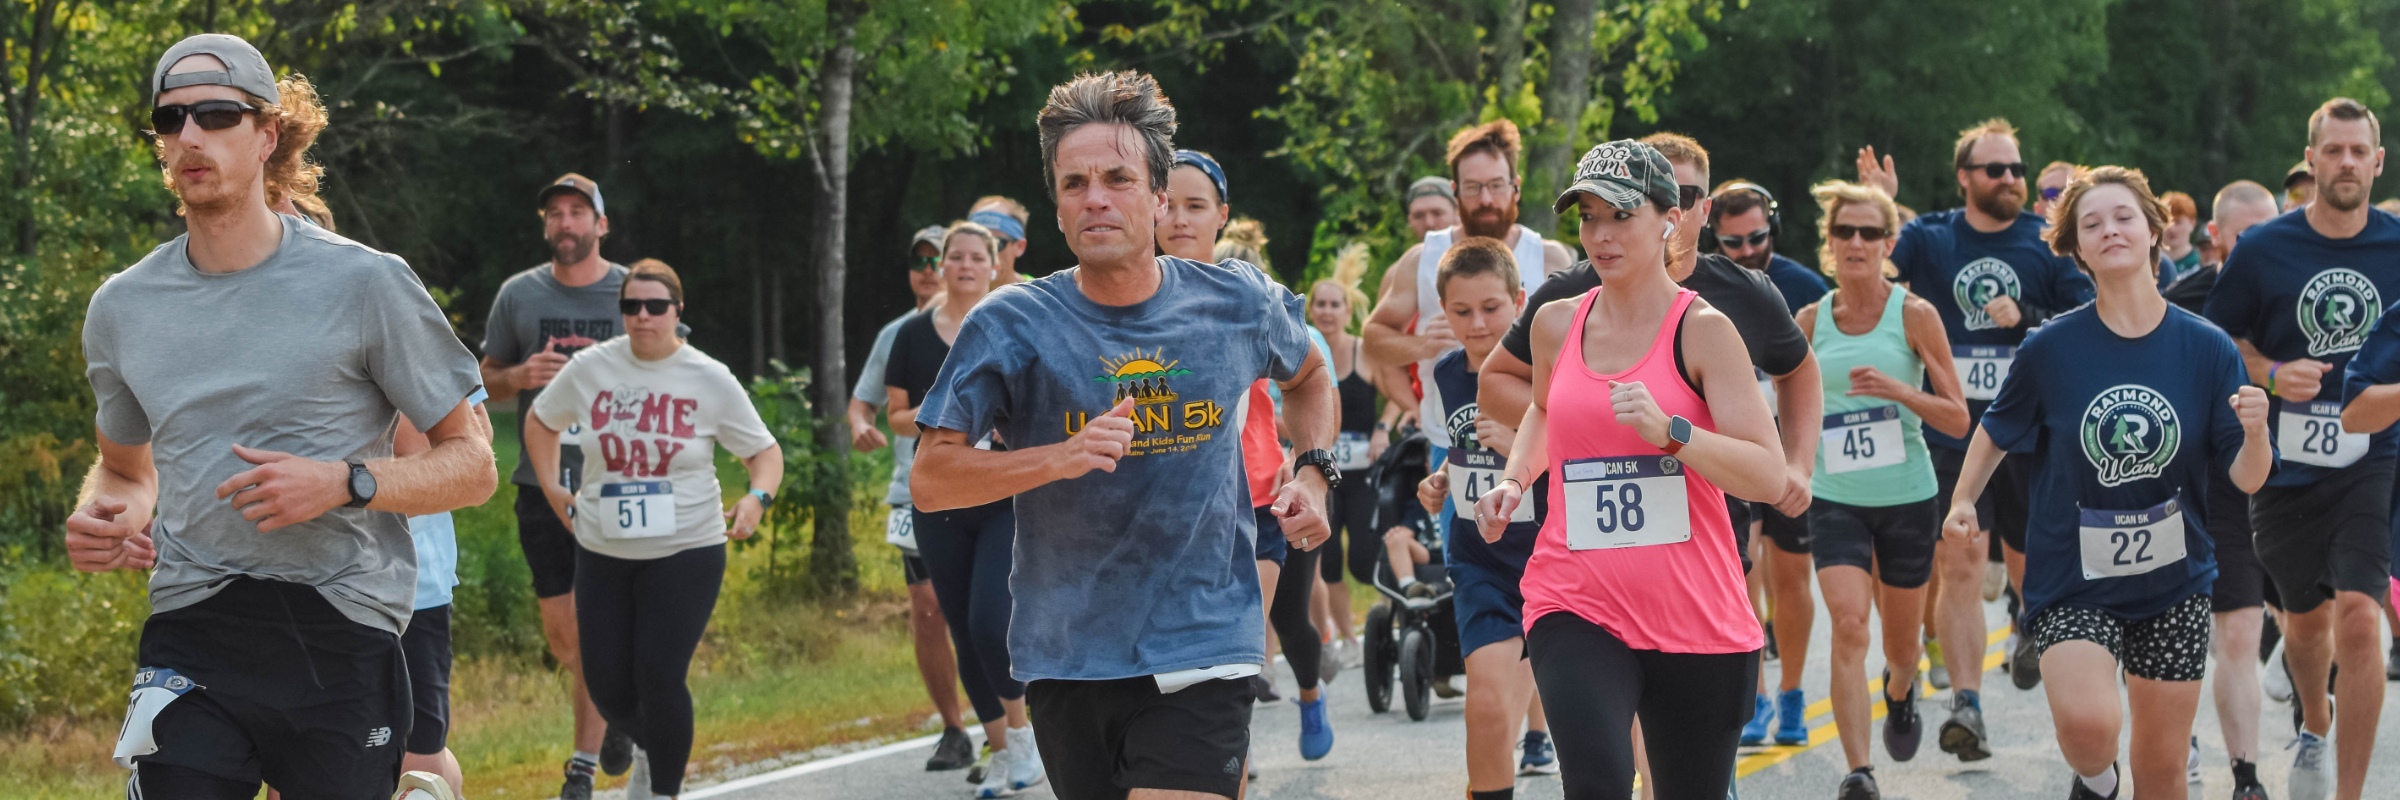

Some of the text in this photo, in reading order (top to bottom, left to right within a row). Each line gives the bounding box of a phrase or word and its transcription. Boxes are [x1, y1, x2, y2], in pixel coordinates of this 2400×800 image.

[1589, 147, 1628, 160] DOG
[1961, 262, 2014, 284] RAYMOND
[2307, 273, 2374, 301] RAYMOND
[1968, 362, 1998, 390] 48
[591, 390, 698, 439] GME
[1101, 404, 1173, 435] AN
[2090, 389, 2171, 422] RAYMOND
[1448, 408, 1481, 437] RAYM
[1131, 438, 1149, 448] and
[1152, 436, 1174, 447] Kids
[1177, 434, 1194, 444] Fun
[1151, 447, 1166, 455] June
[1843, 426, 1875, 460] 45
[2302, 419, 2339, 455] 28
[599, 433, 685, 477] DAY
[1467, 454, 1495, 466] UCAN 5K
[1605, 462, 1624, 475] CAN
[1626, 461, 1639, 474] 5K
[618, 498, 647, 528] 51
[1596, 482, 1645, 534] 58
[2114, 513, 2149, 525] UCAN 5K
[890, 511, 913, 537] 56
[2110, 530, 2154, 567] 22
